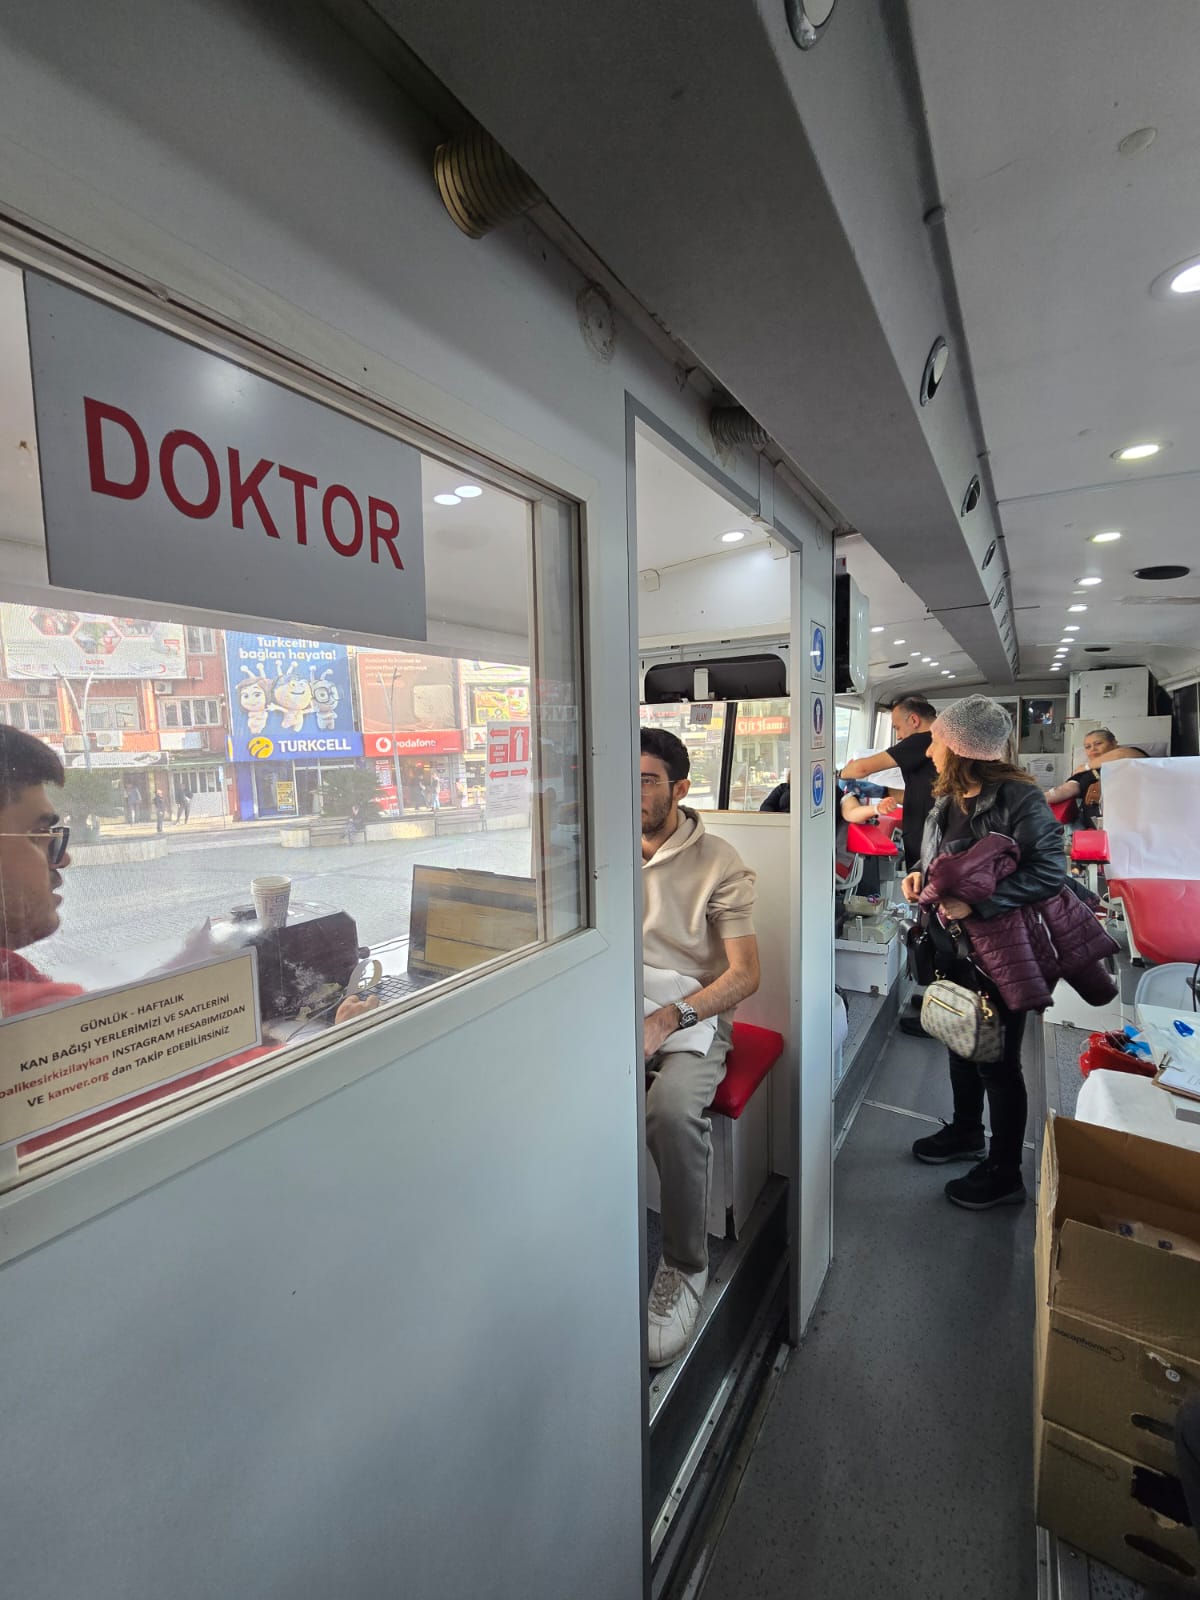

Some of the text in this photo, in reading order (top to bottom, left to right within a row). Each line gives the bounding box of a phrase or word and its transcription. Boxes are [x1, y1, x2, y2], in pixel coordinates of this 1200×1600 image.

[83, 396, 405, 570] DOKTOR
[239, 647, 337, 662] bağlan hayata!
[278, 738, 352, 753] TURKCELL
[20, 992, 230, 1072] KAN BAĞIŞI YERLERİMİZİ VE SAATLERİNİ
[80, 1011, 128, 1033] GÜNLÜK
[137, 993, 184, 1015] HAFTALIK
[112, 1029, 175, 1059] INSTAGRAM
[177, 1004, 246, 1036] HESABIMIZDAN
[27, 1025, 231, 1108] VE kanver.org dan TAKİP EDEBİLİRSİNİZ
